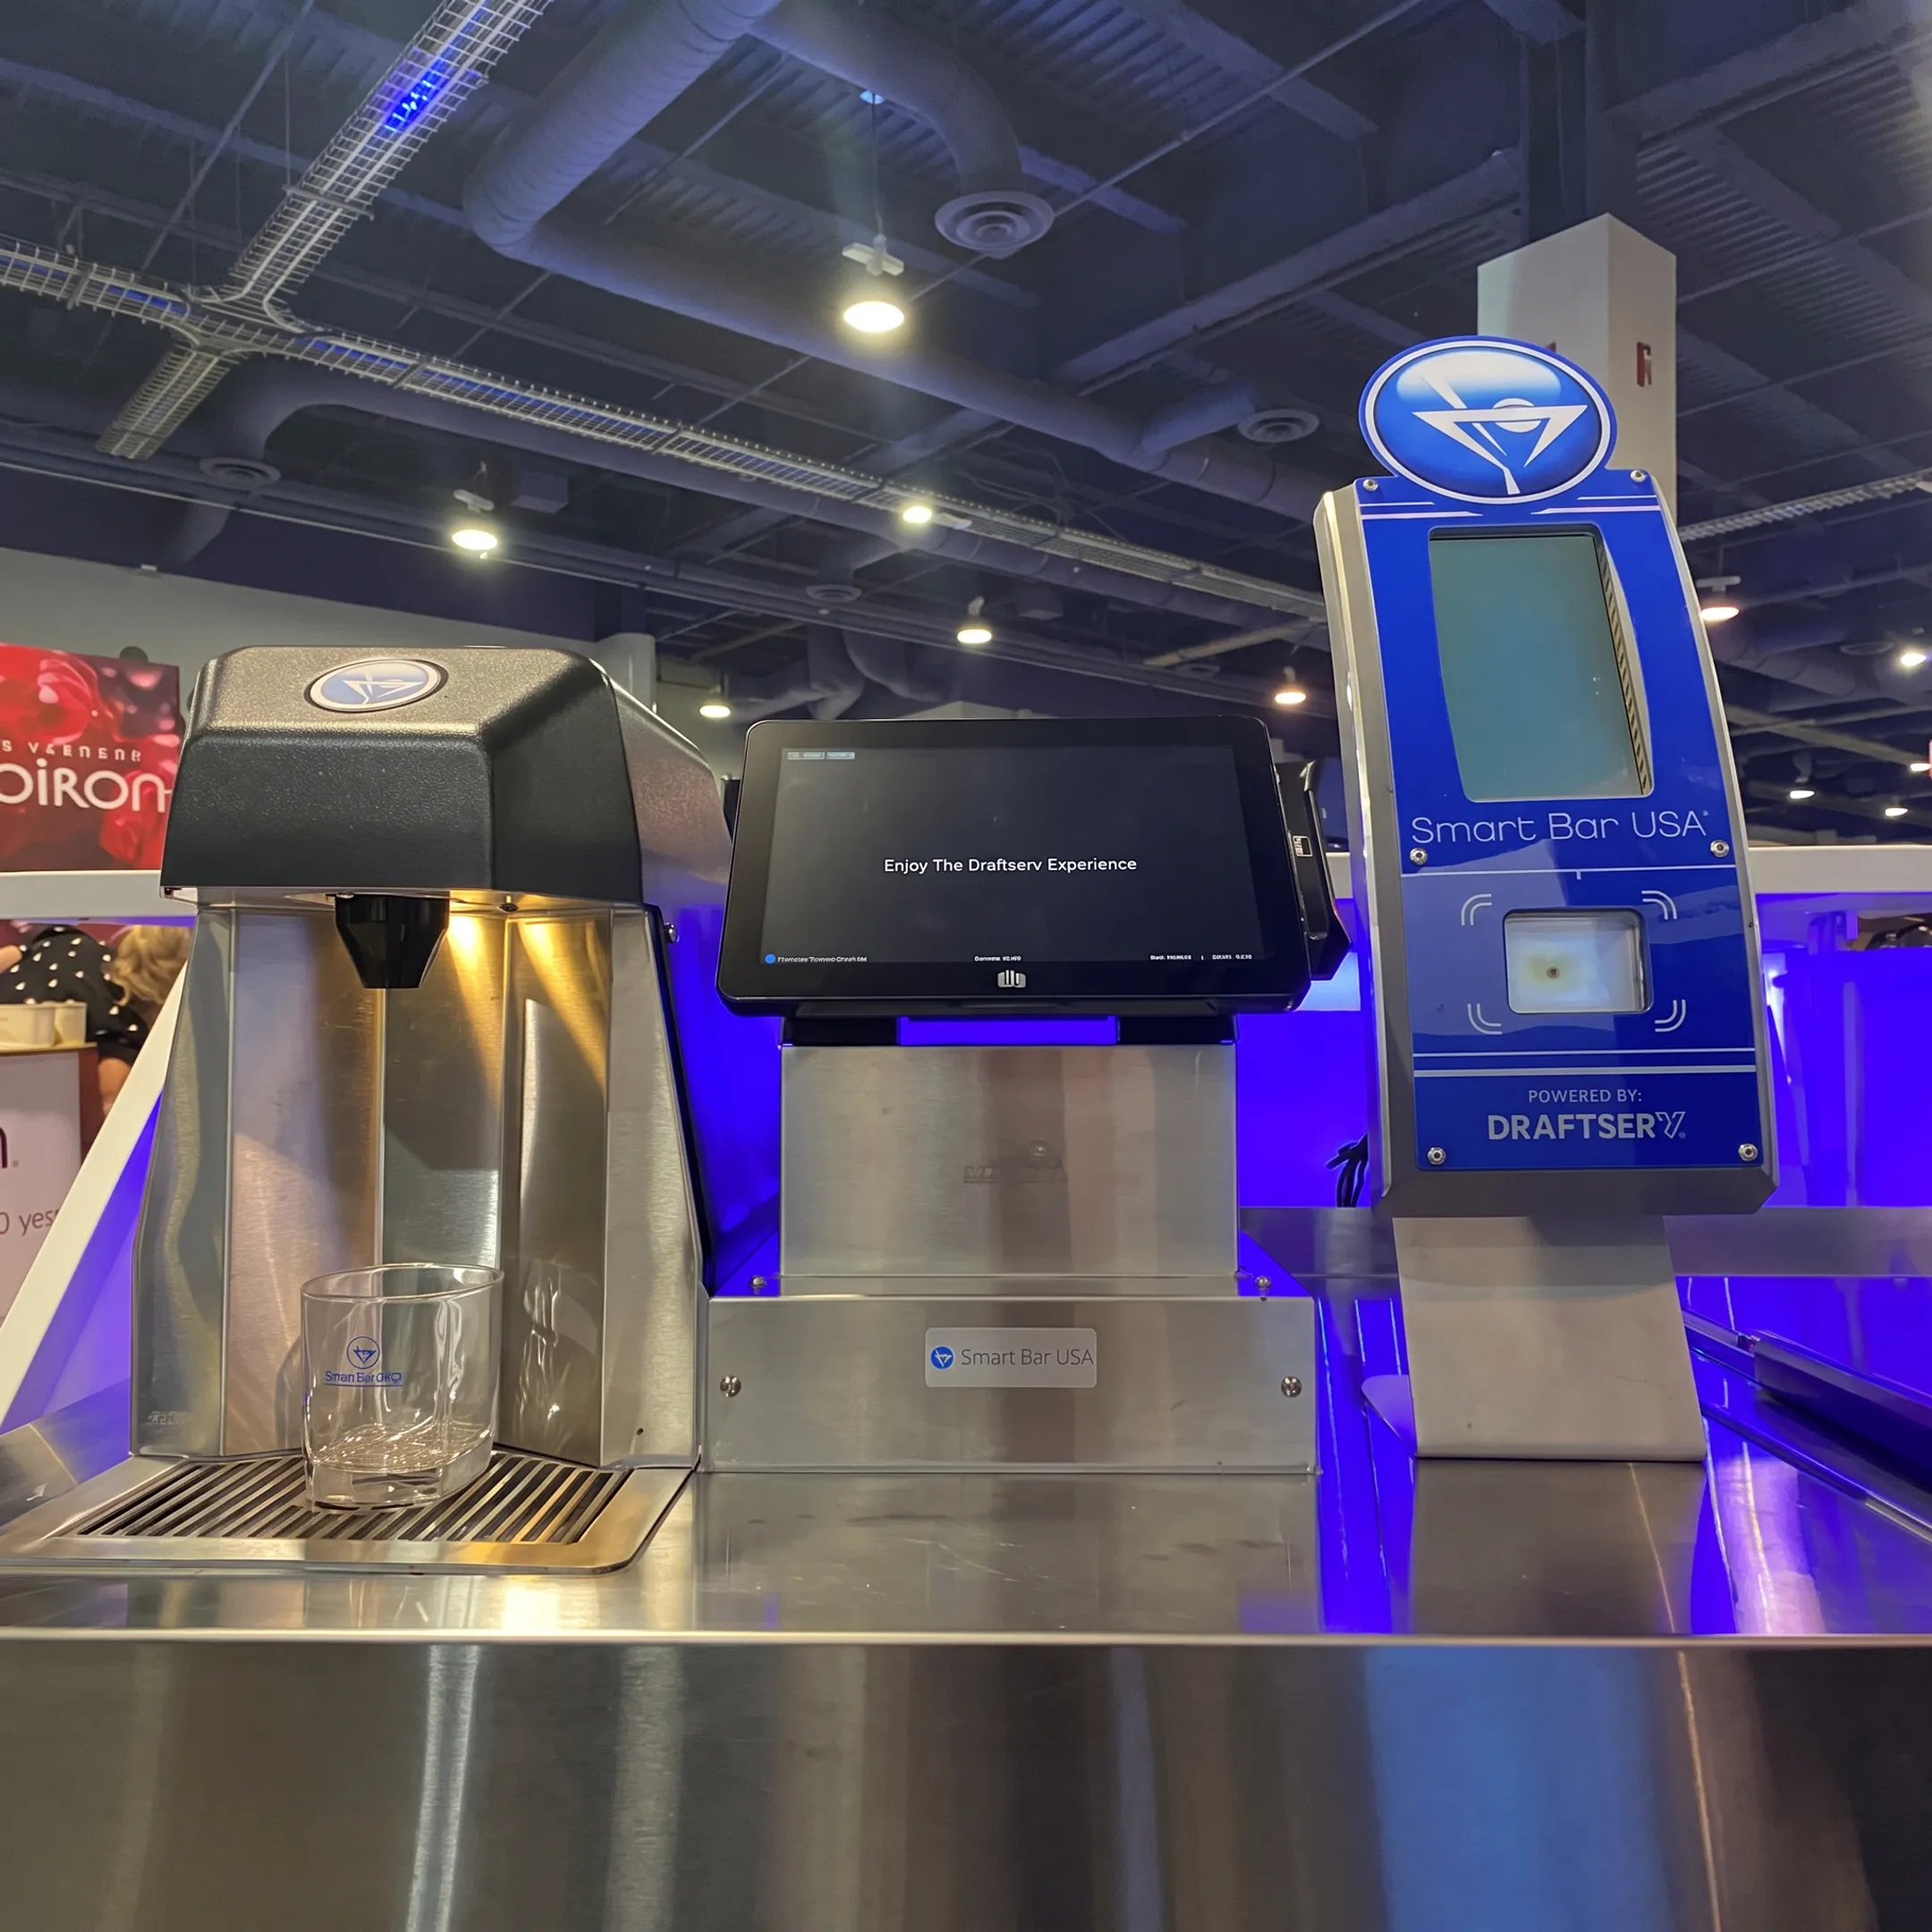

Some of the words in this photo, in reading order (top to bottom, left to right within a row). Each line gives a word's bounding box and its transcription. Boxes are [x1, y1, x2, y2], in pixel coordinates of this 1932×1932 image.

[1411, 817, 1537, 844] Smart
[1548, 812, 1620, 840] Bar
[884, 859, 928, 875] Enjoy
[933, 859, 963, 872] The
[969, 858, 1043, 872] Draftserv
[1047, 857, 1138, 874] Experience
[1529, 1089, 1612, 1104] POWERED
[1617, 1089, 1643, 1103] BY:
[961, 1349, 1016, 1366] Smart
[1021, 1349, 1052, 1366] Bar
[1056, 1349, 1095, 1366] USA
